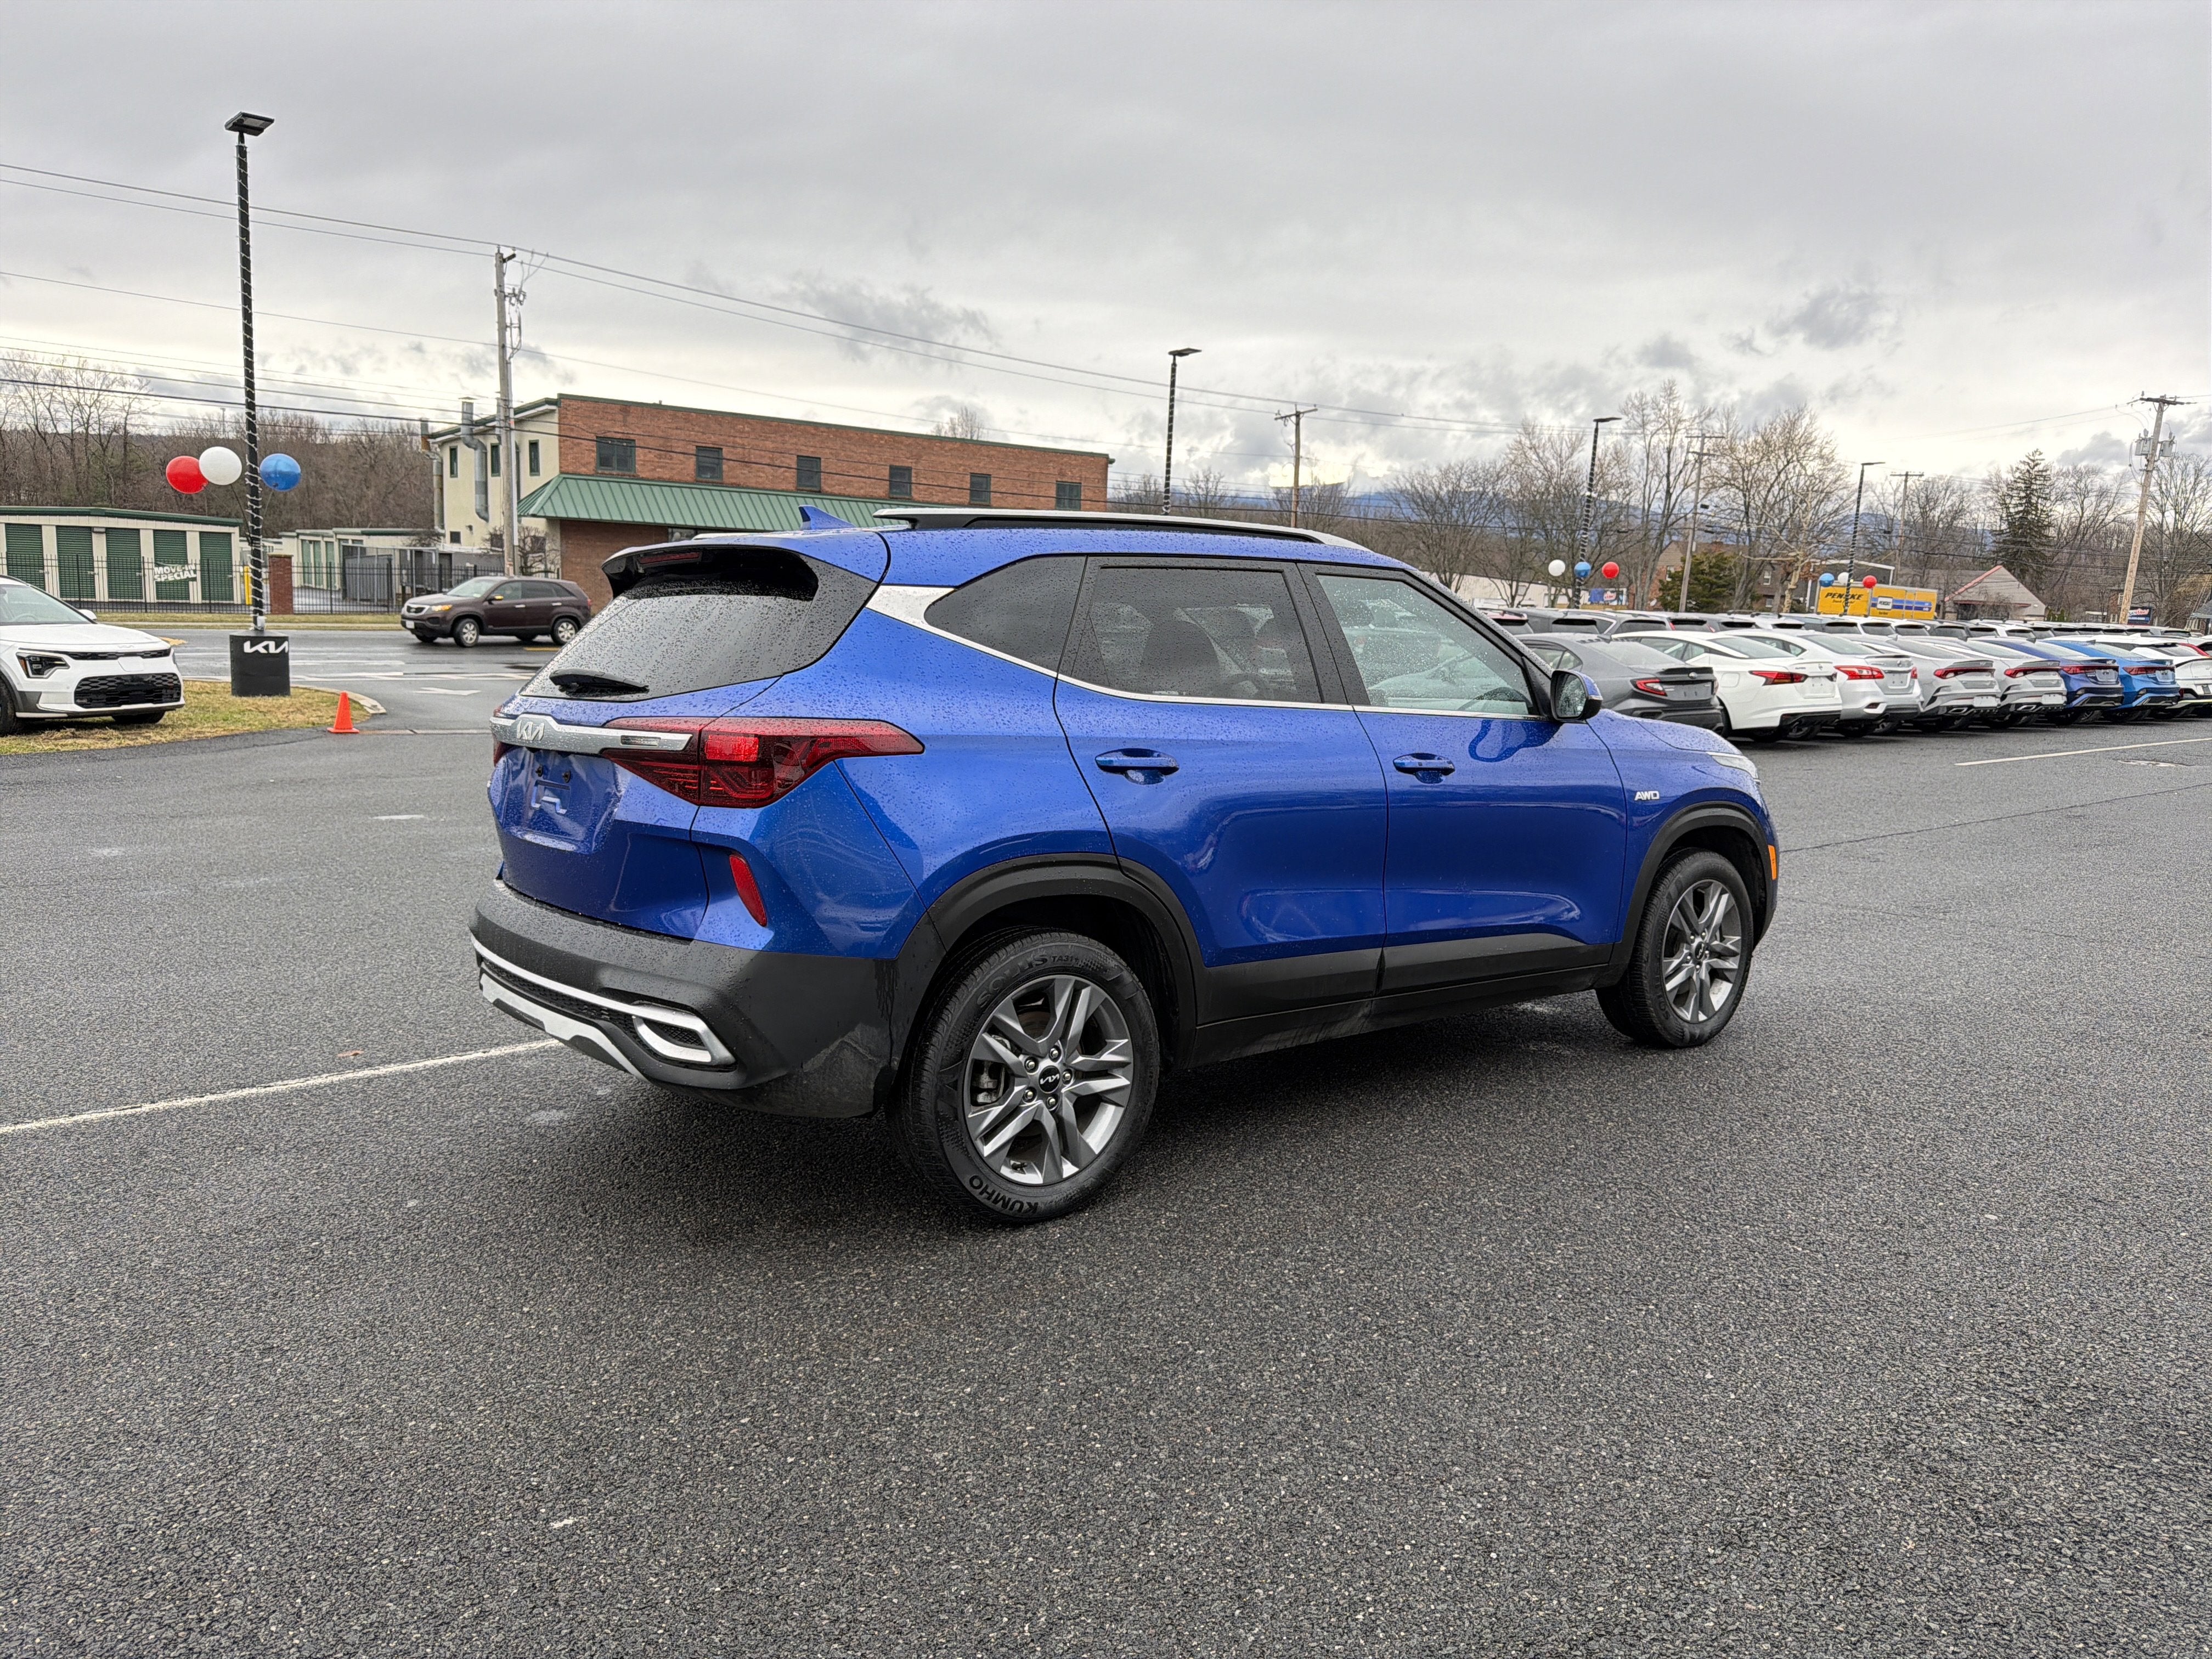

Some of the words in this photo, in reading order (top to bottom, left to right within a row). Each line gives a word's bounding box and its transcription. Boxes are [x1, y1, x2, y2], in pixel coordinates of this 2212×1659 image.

[154, 563, 196, 574] MOVE-IN
[154, 570, 196, 582] SPECIAL
[1825, 592, 1864, 600] PENKE
[244, 640, 288, 653] KIA
[517, 719, 545, 741] KIA
[1634, 791, 1660, 800] AWD
[969, 1175, 1039, 1214] KUMHO
